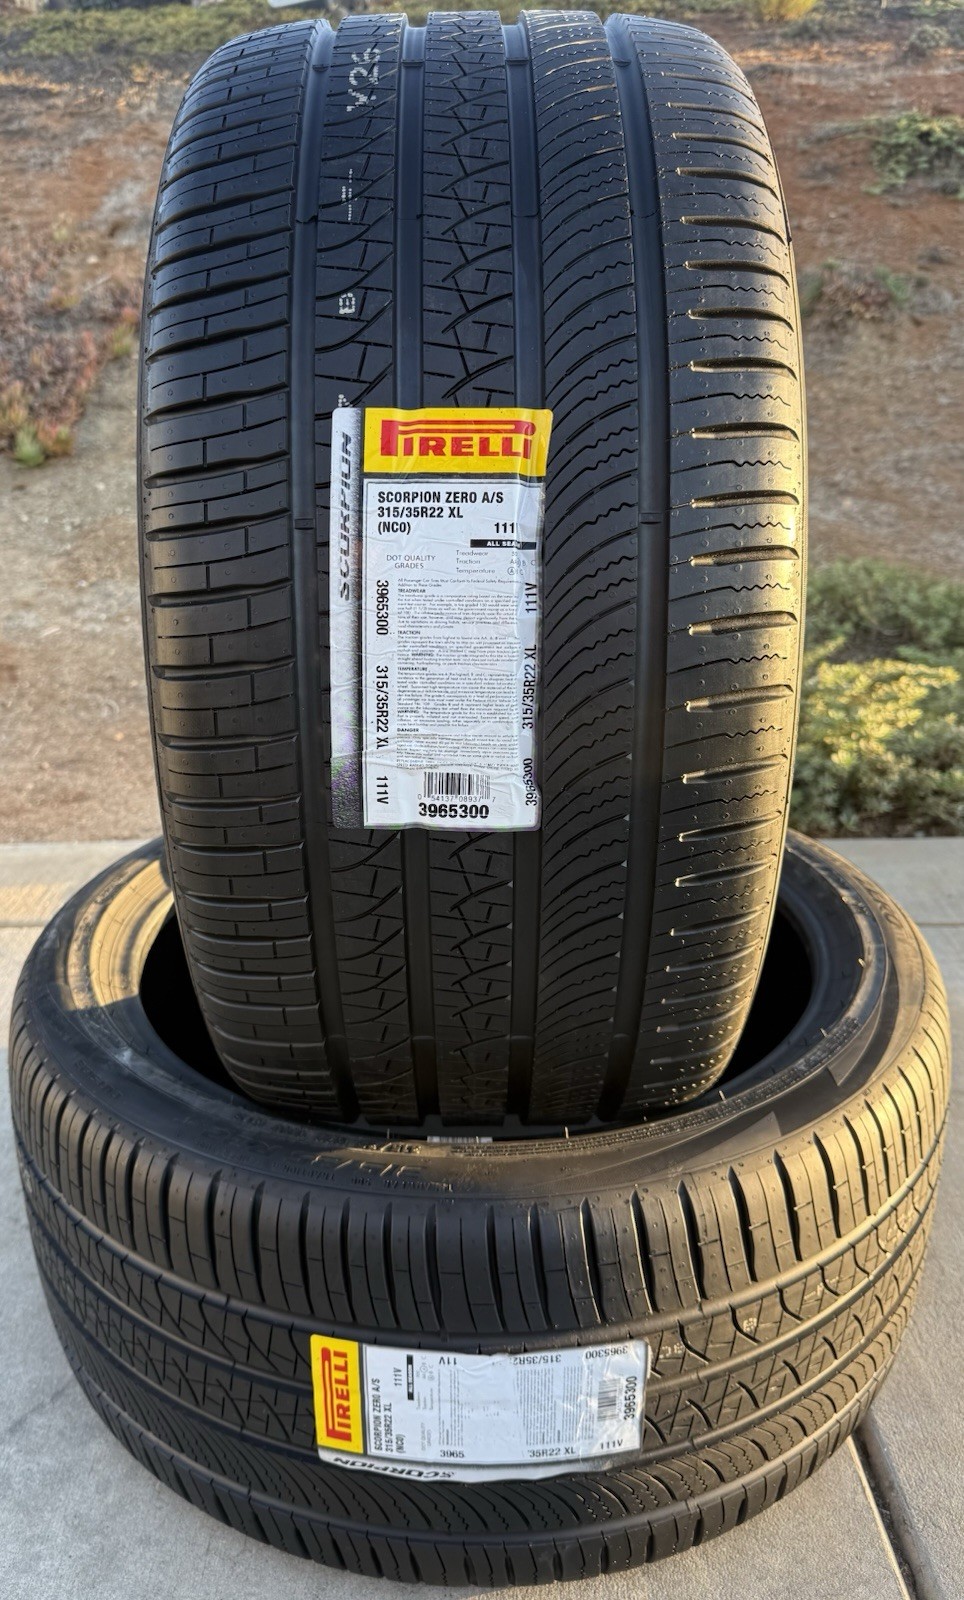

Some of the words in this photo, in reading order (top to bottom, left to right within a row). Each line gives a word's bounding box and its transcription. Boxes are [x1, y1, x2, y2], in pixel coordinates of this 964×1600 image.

[380, 419, 536, 459] PIRELLI
[378, 491, 441, 503] SCORPION
[445, 491, 477, 503] ZERO
[482, 491, 504, 503] A/S
[339, 432, 351, 601] SCORPION
[377, 506, 444, 518] 315/35R22
[448, 506, 464, 518] XL
[494, 522, 518, 534] 111
[404, 554, 436, 562] QUALITY
[376, 580, 389, 635] 3965300
[524, 583, 537, 613] 111V
[525, 644, 537, 660] XL
[376, 665, 389, 732] 315/35R22
[522, 664, 536, 729] 315/35R22
[376, 775, 389, 804] 111V
[522, 758, 538, 806] 3965300
[418, 802, 490, 819] 3965300
[510, 1354, 561, 1365] 315/35R2
[585, 1345, 629, 1359] 3965300
[393, 1367, 402, 1387] 111V
[321, 1347, 352, 1442] PIRELLI
[624, 1375, 637, 1420] 3965300
[373, 1412, 383, 1451] SCORPION
[528, 1448, 561, 1458] 35R22
[564, 1446, 576, 1455] XL
[333, 1457, 455, 1478] SCORPION
